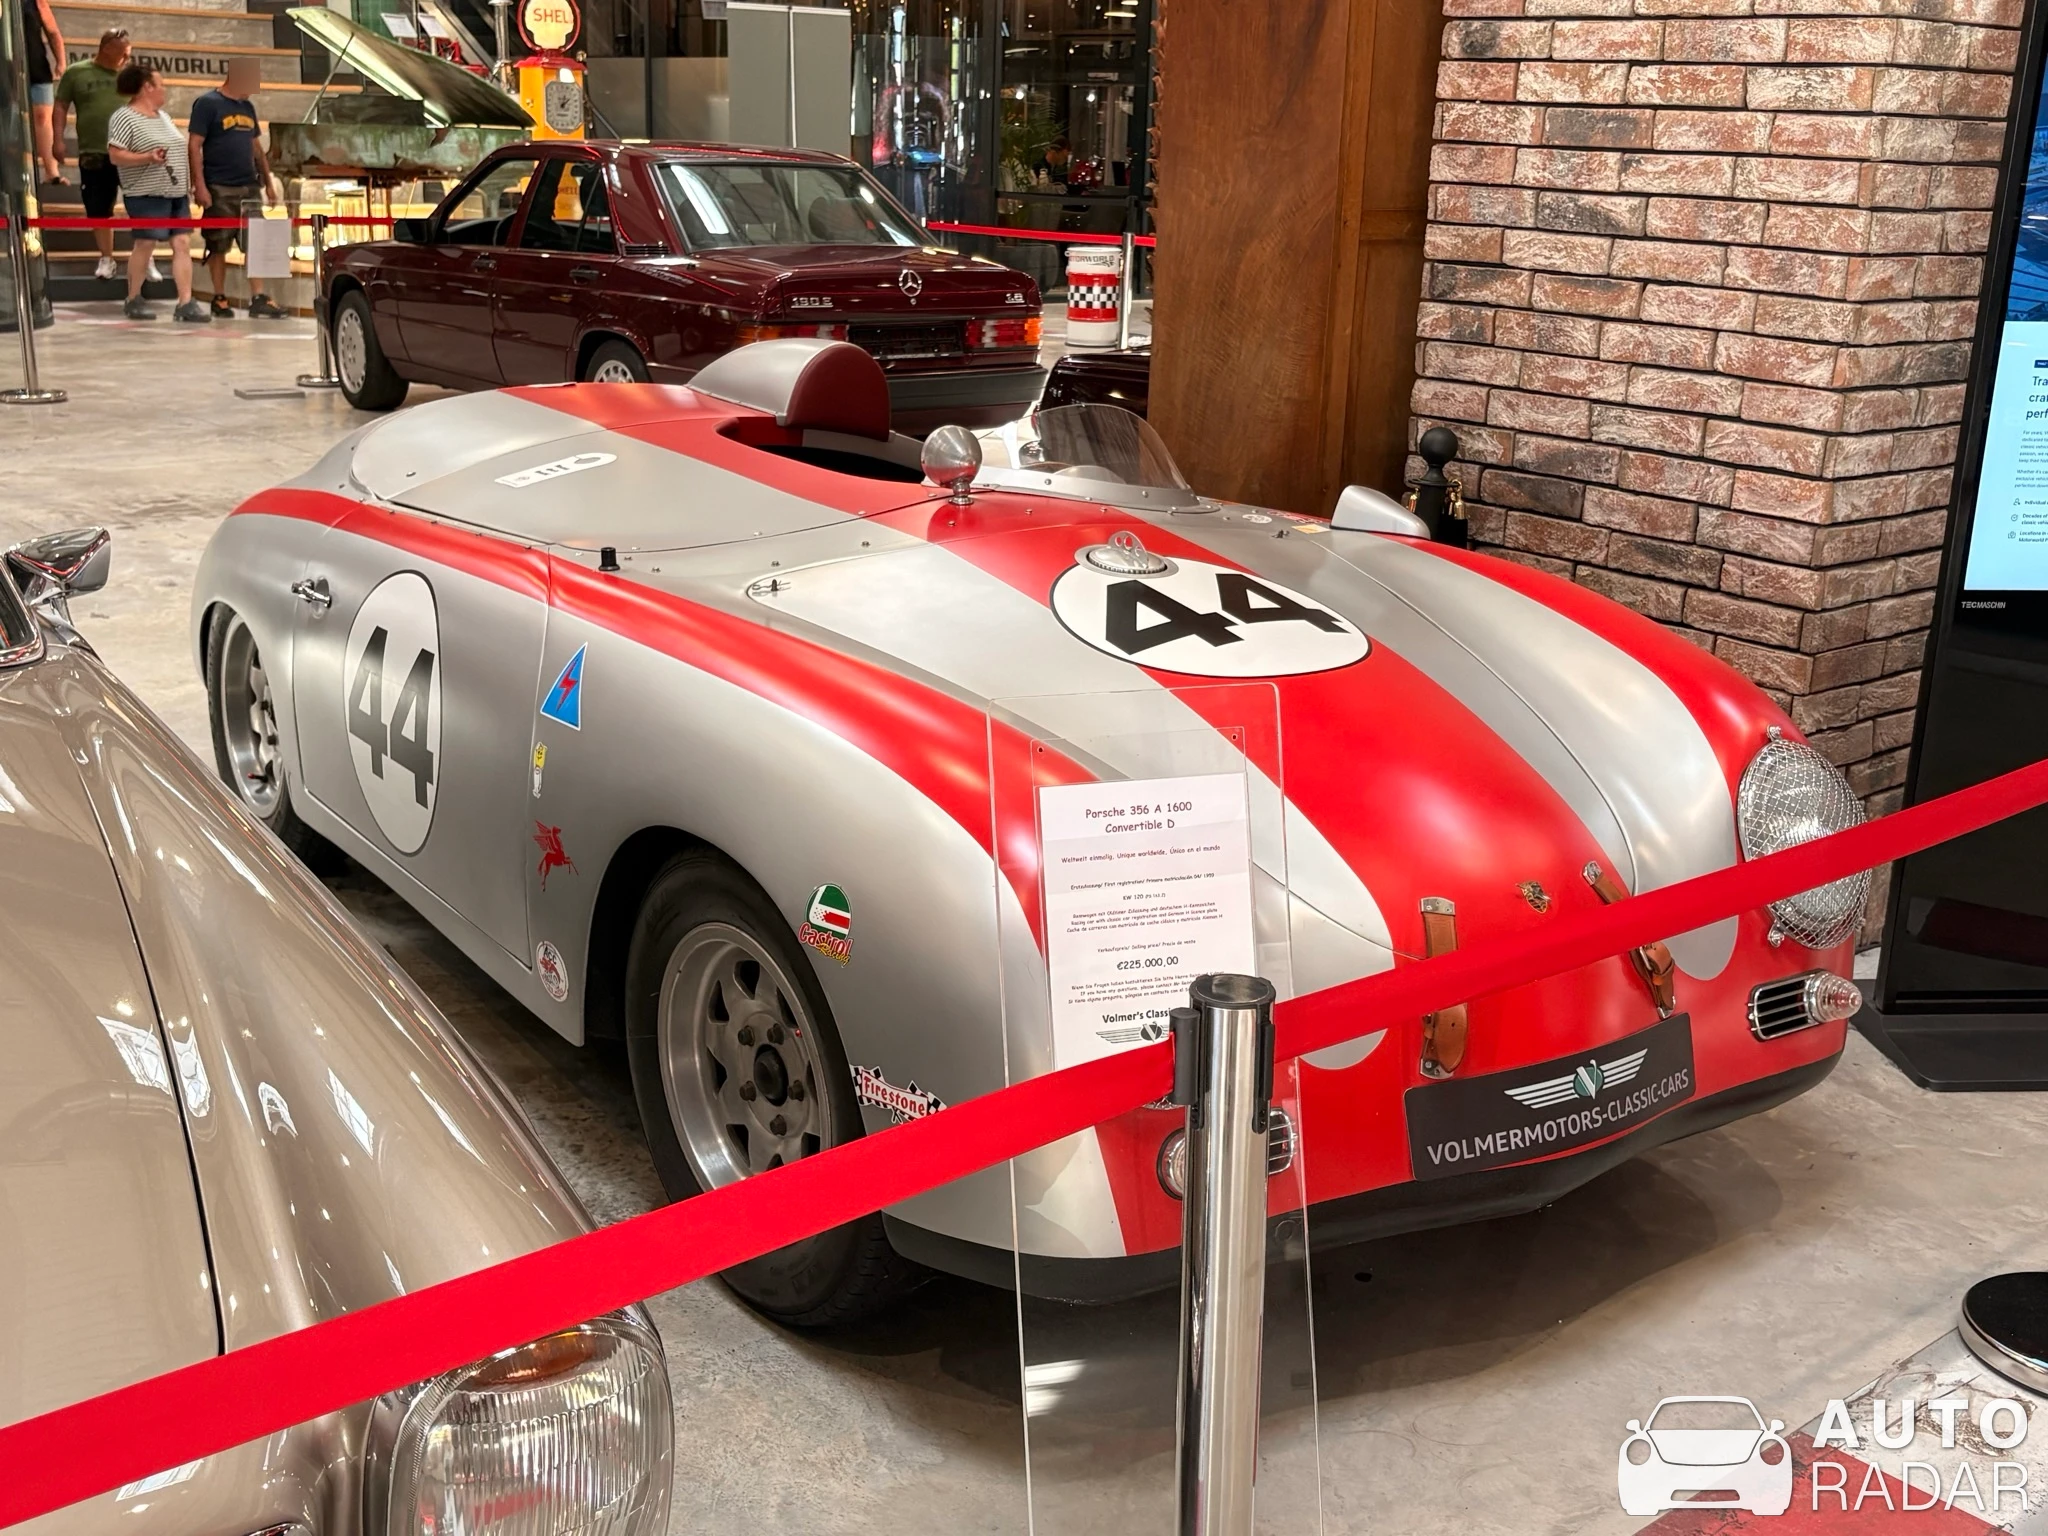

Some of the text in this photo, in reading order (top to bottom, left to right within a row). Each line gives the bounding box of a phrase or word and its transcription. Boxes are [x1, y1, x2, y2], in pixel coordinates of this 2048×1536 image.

[533, 8, 574, 24] SHEL
[69, 51, 229, 75] MORWORLD
[1105, 573, 1351, 656] 44
[349, 625, 435, 810] 44
[1085, 801, 1193, 819] Porsche 356 A 1600
[1105, 818, 1175, 833] Convertible D
[1061, 855, 1088, 864] Weltweit
[1116, 851, 1136, 860] Unique
[1203, 844, 1221, 852] mundo
[1133, 893, 1144, 901] 120
[799, 920, 855, 958] Castrol
[816, 941, 853, 967] Racing
[1116, 956, 1179, 971] €225.000,00
[1102, 1011, 1144, 1024] Volmer's
[863, 1074, 927, 1117] Firestone
[1426, 1068, 1690, 1166] VOLMERMOTORS-CLASSIC-CARS
